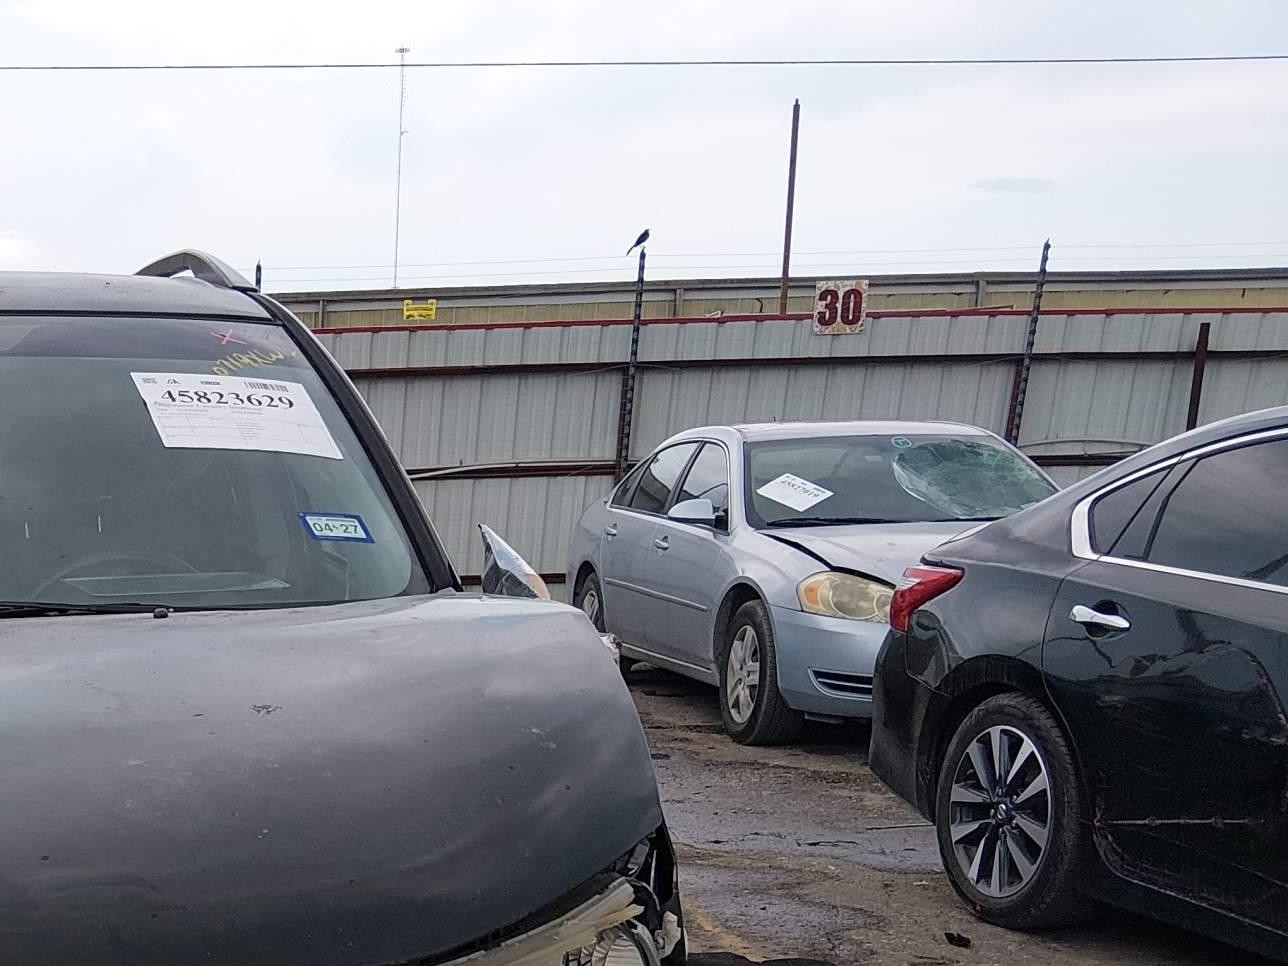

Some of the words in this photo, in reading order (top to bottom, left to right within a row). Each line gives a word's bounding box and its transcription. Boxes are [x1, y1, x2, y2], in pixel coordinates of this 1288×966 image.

[817, 288, 863, 326] 30
[161, 389, 294, 409] 45823629
[313, 522, 333, 533] 04
[340, 523, 358, 534] 27
